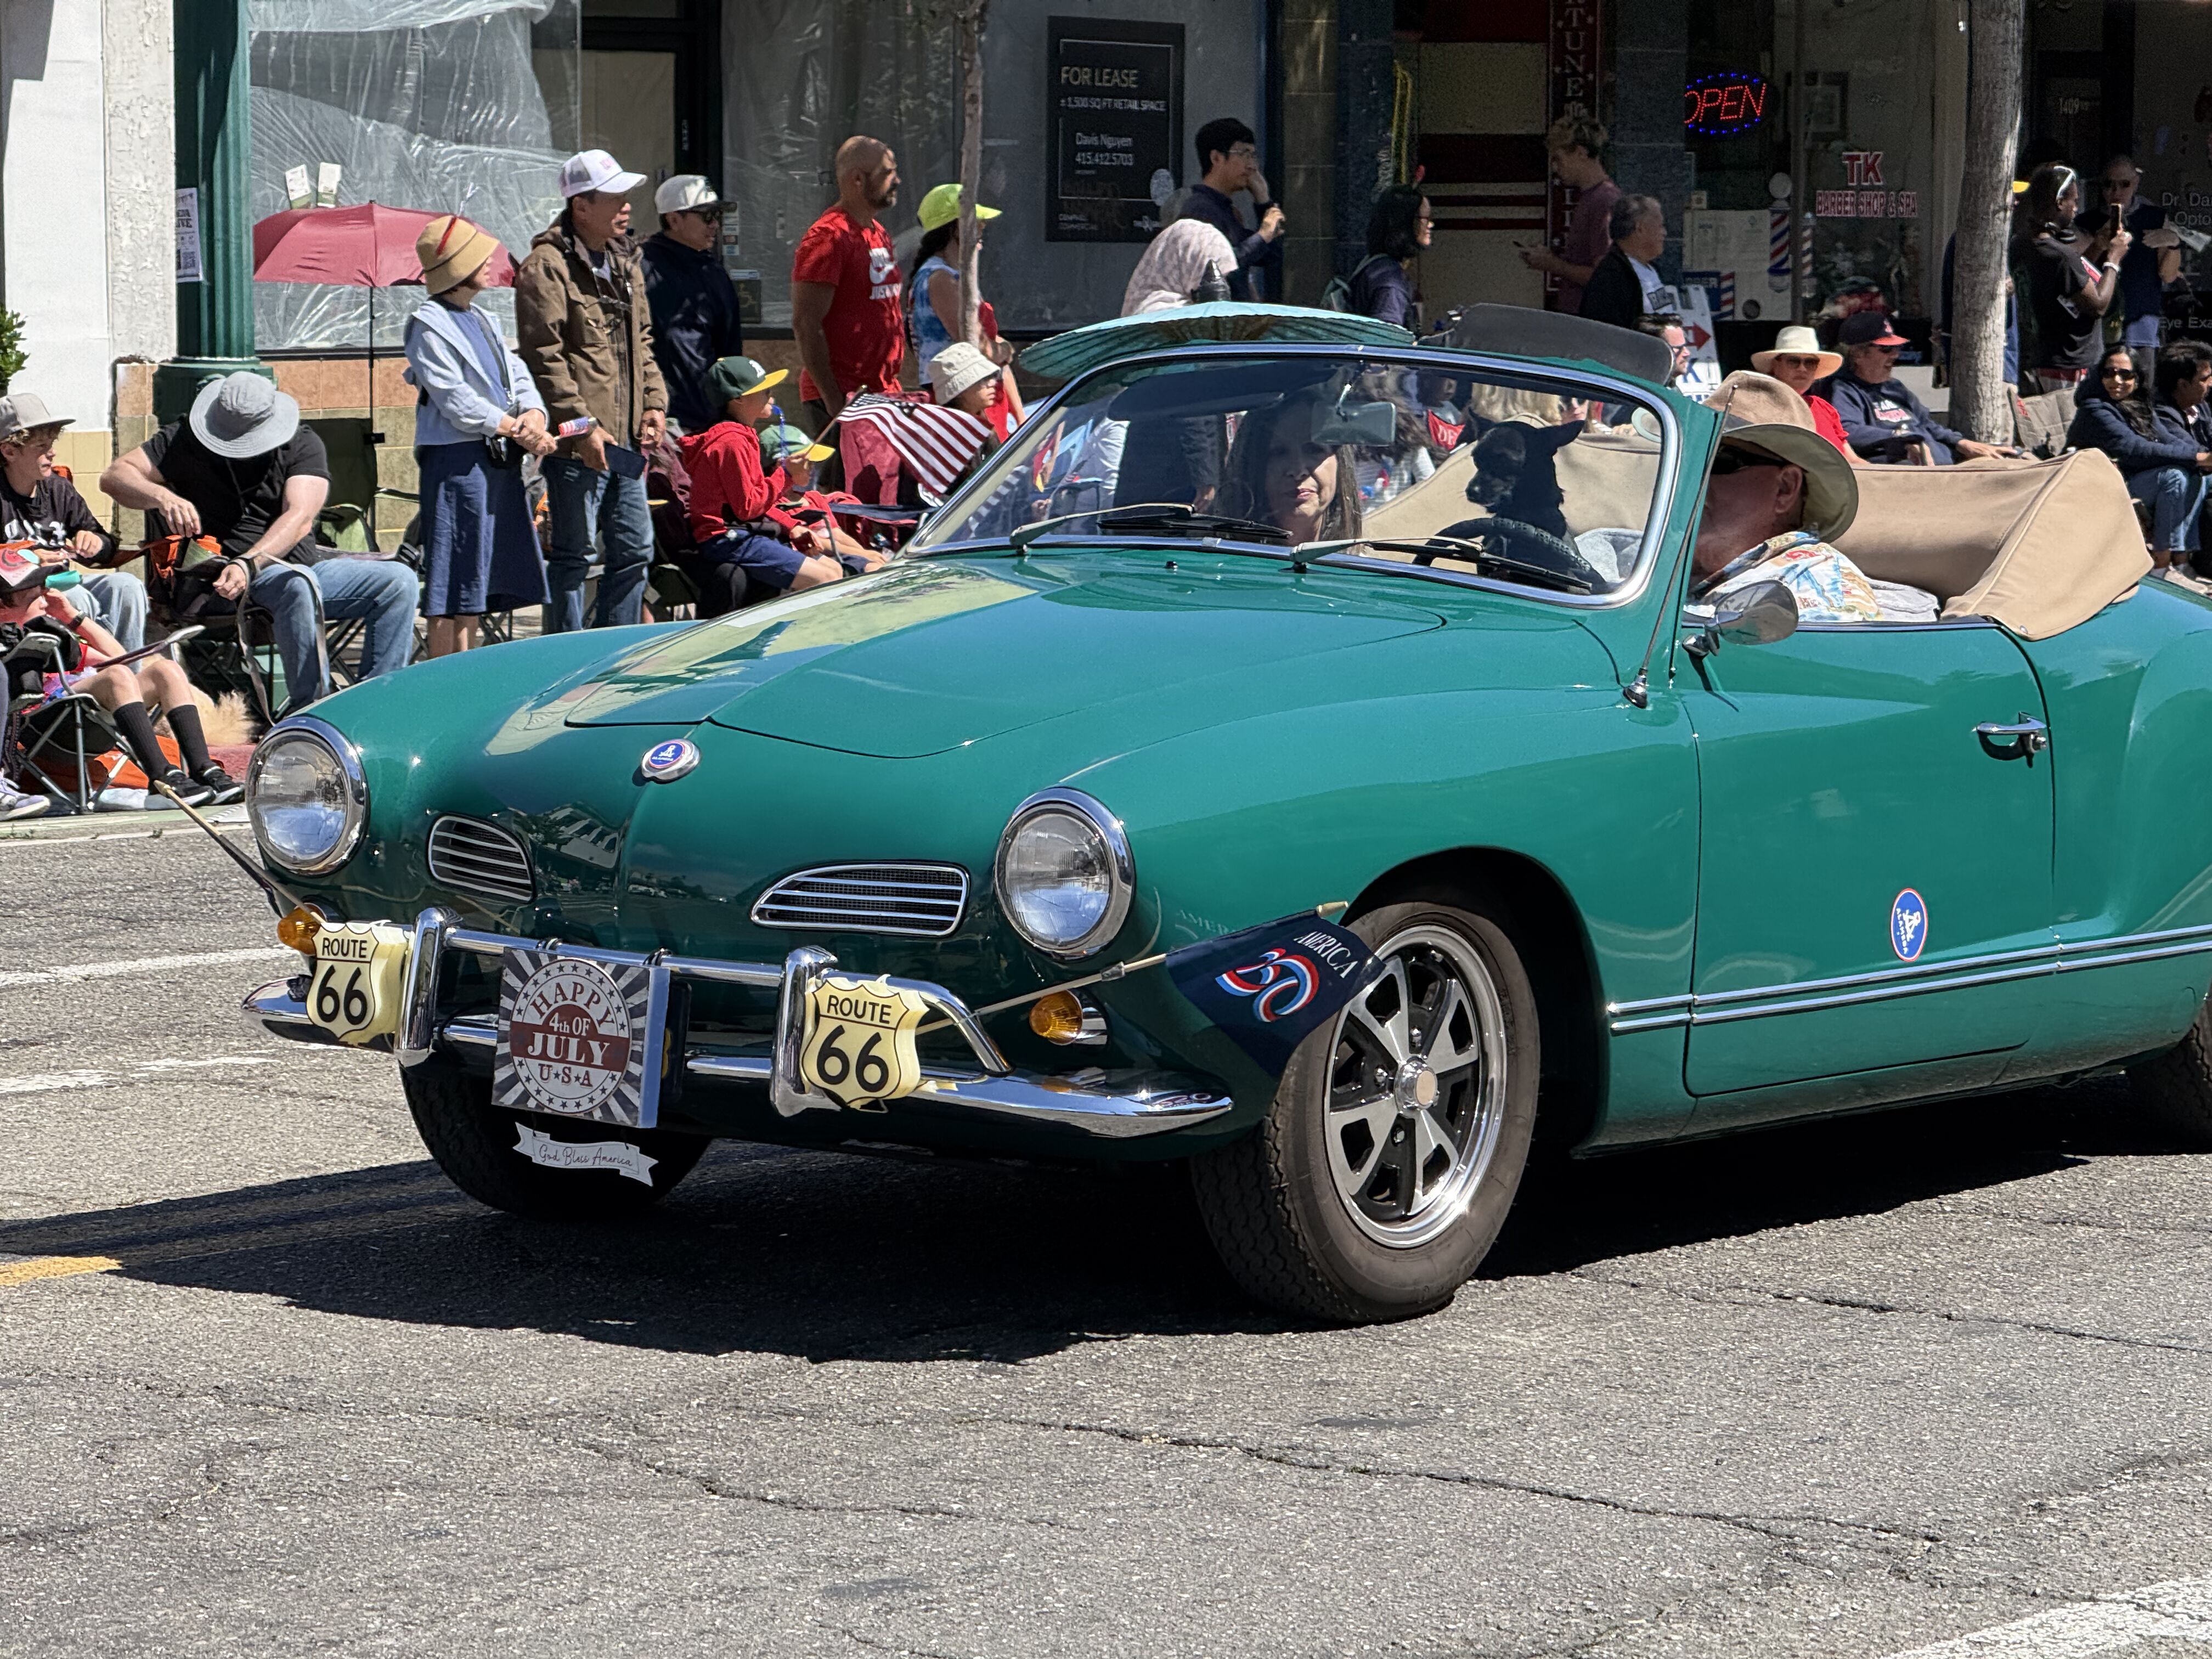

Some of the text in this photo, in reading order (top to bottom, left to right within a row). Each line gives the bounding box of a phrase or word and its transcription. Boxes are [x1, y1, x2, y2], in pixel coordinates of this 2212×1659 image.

[1061, 66, 1139, 88] FOR LEASE
[1102, 98, 1113, 109] FT
[1113, 99, 1141, 110] RETAIL
[1141, 99, 1167, 111] SPACE
[1100, 134, 1133, 149] Nguyen
[1842, 151, 1883, 185] TK
[1816, 190, 1917, 218] BARBER SHOP & SPA
[2159, 316, 2183, 330] Eye
[321, 937, 367, 958] ROUTE
[1293, 930, 1358, 979] AMERICA
[317, 964, 368, 1025] 66
[530, 981, 615, 1028] HAPPY
[549, 1012, 591, 1036] 4th OF
[827, 995, 892, 1025] ROUTE
[527, 1031, 611, 1066] JULY
[817, 1024, 889, 1092] 66
[539, 1144, 633, 1167] God Bless America
